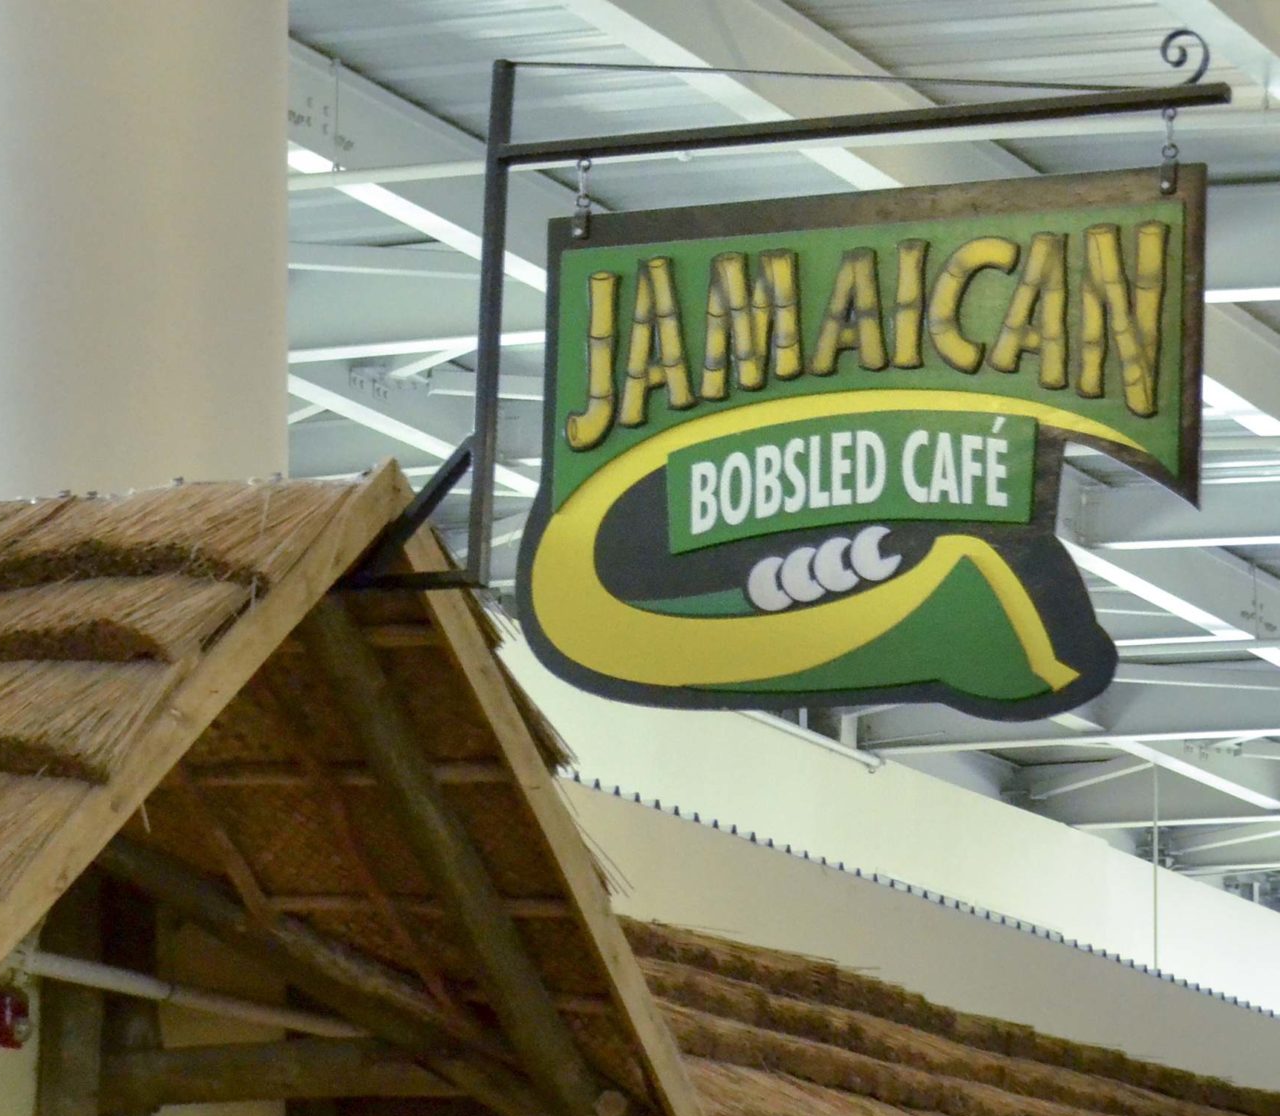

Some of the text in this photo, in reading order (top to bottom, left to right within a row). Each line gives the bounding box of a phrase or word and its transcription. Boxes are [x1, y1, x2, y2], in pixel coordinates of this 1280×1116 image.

[565, 219, 1170, 453] JAMAICAN
[690, 415, 1009, 535] BOBSLED CAFÉ
